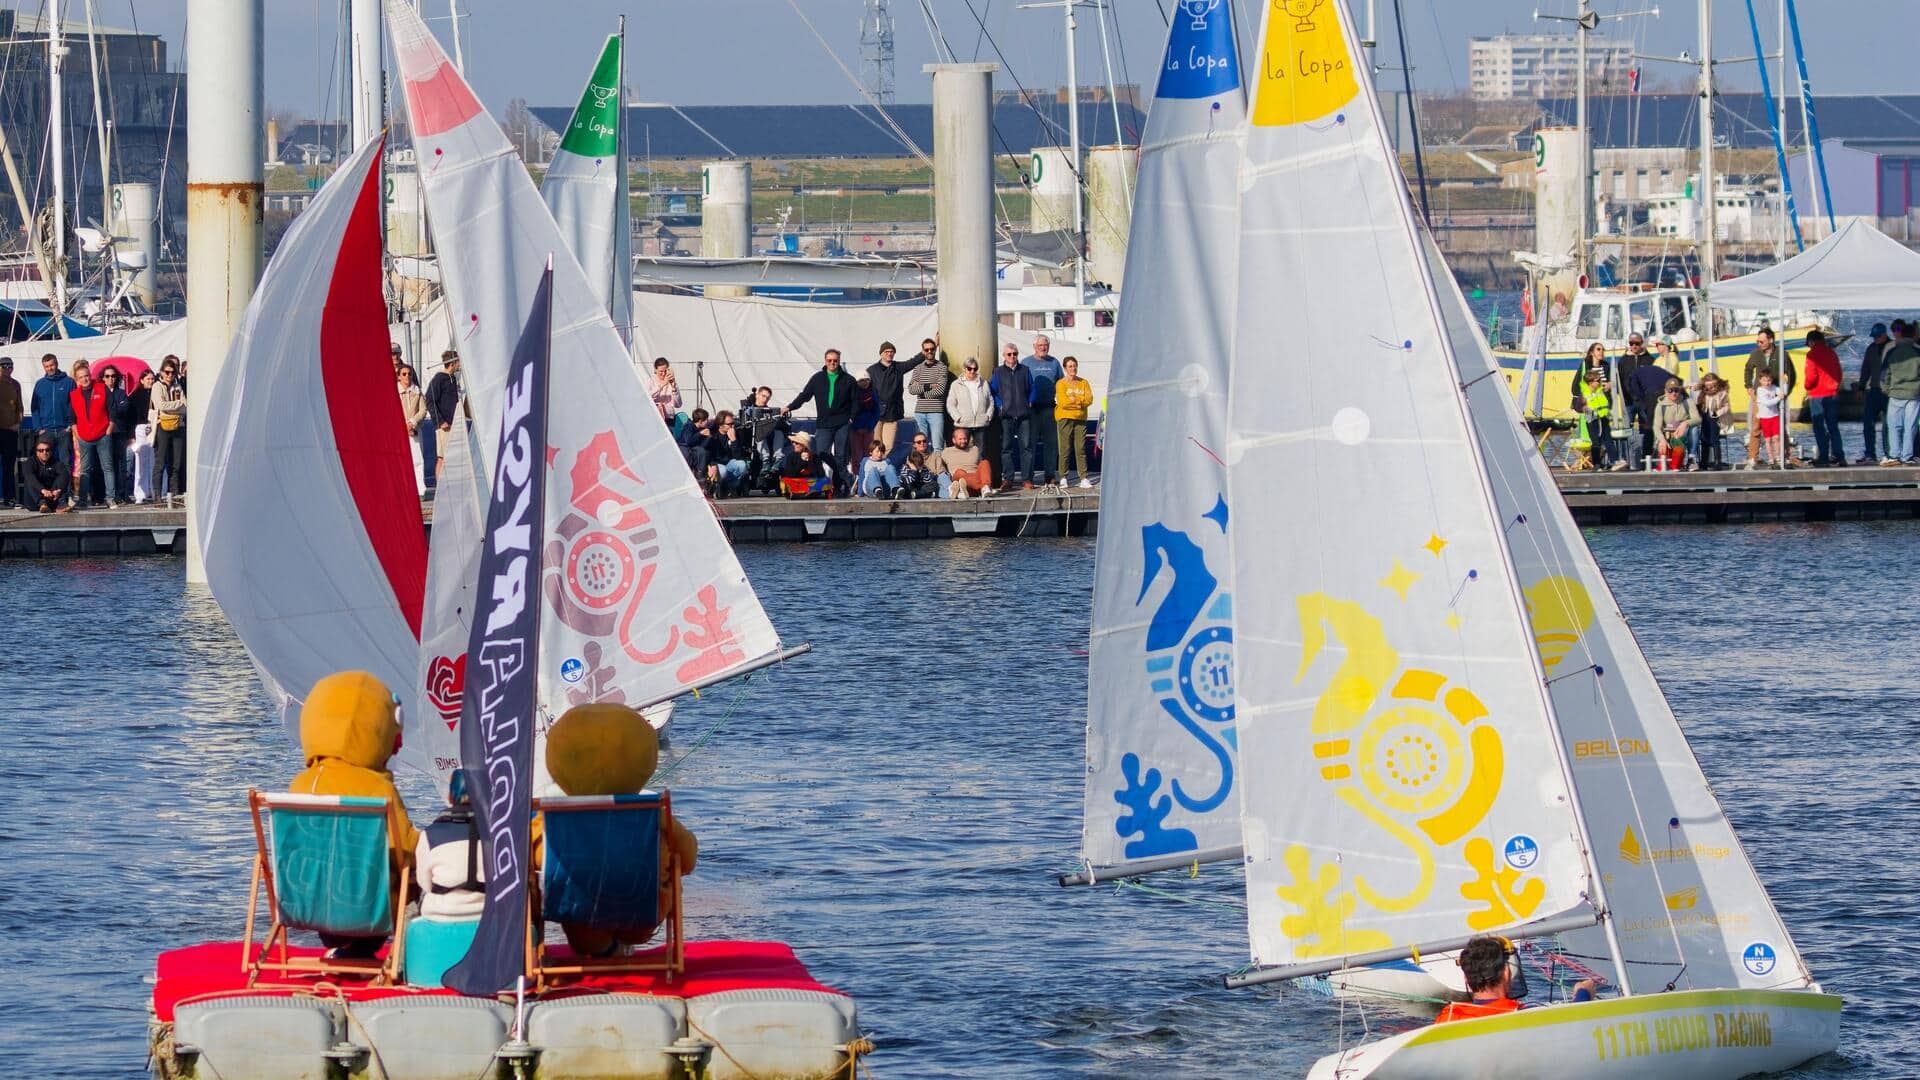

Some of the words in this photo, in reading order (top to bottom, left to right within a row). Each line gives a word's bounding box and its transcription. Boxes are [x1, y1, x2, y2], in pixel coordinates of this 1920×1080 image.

[1166, 45, 1179, 71] la
[1188, 45, 1228, 78] Copa
[1266, 52, 1285, 80] la
[1299, 50, 1344, 83] Copa
[589, 115, 614, 140] Copa
[1209, 664, 1229, 686] 11
[1592, 1019, 1650, 1061] 11TH
[1653, 1013, 1711, 1055] HOUR
[1713, 1011, 1772, 1049] RACING
